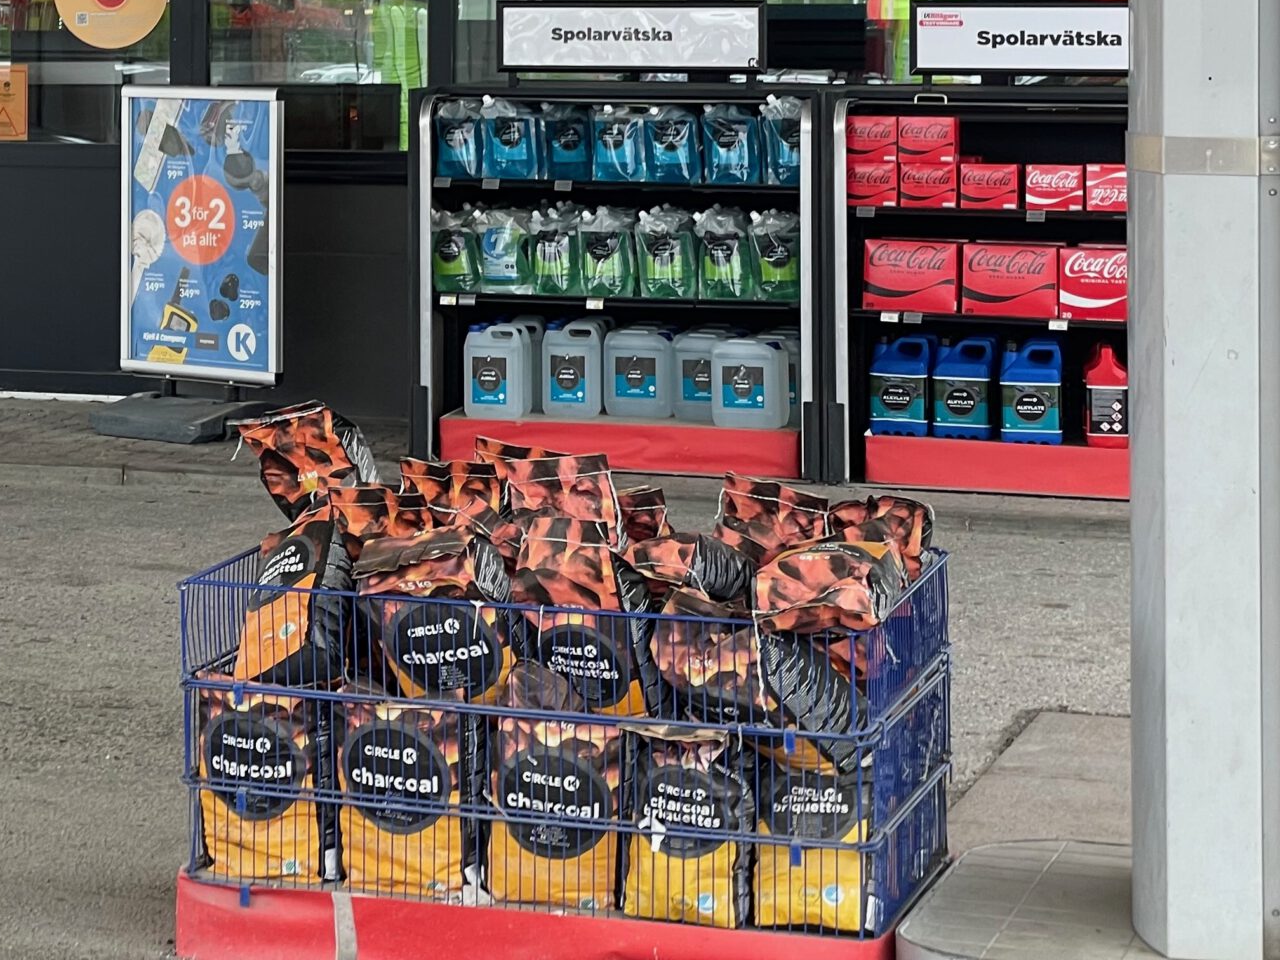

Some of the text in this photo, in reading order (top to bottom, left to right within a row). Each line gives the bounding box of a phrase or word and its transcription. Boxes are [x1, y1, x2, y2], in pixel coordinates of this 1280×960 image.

[551, 27, 673, 43] Spolarvätska
[977, 29, 1122, 49] Spolarvätska
[1026, 170, 1082, 188] Coca-Cola
[174, 196, 226, 230] 3 för 2
[183, 234, 197, 247] på
[1065, 251, 1127, 278] Coca-Co
[1062, 311, 1072, 319] 20
[231, 327, 255, 360] K
[407, 623, 444, 638] CIRCLE
[403, 640, 489, 665] charcoal
[584, 645, 597, 657] K
[551, 655, 610, 670] charcoal
[364, 744, 416, 764] CIRCLE K
[212, 753, 292, 778] charcoal
[352, 766, 438, 794] charcoal
[522, 771, 561, 788] CIRCLE
[658, 783, 691, 798] CRCLE
[507, 792, 600, 819] charcoal
[650, 795, 715, 817] charcoal
